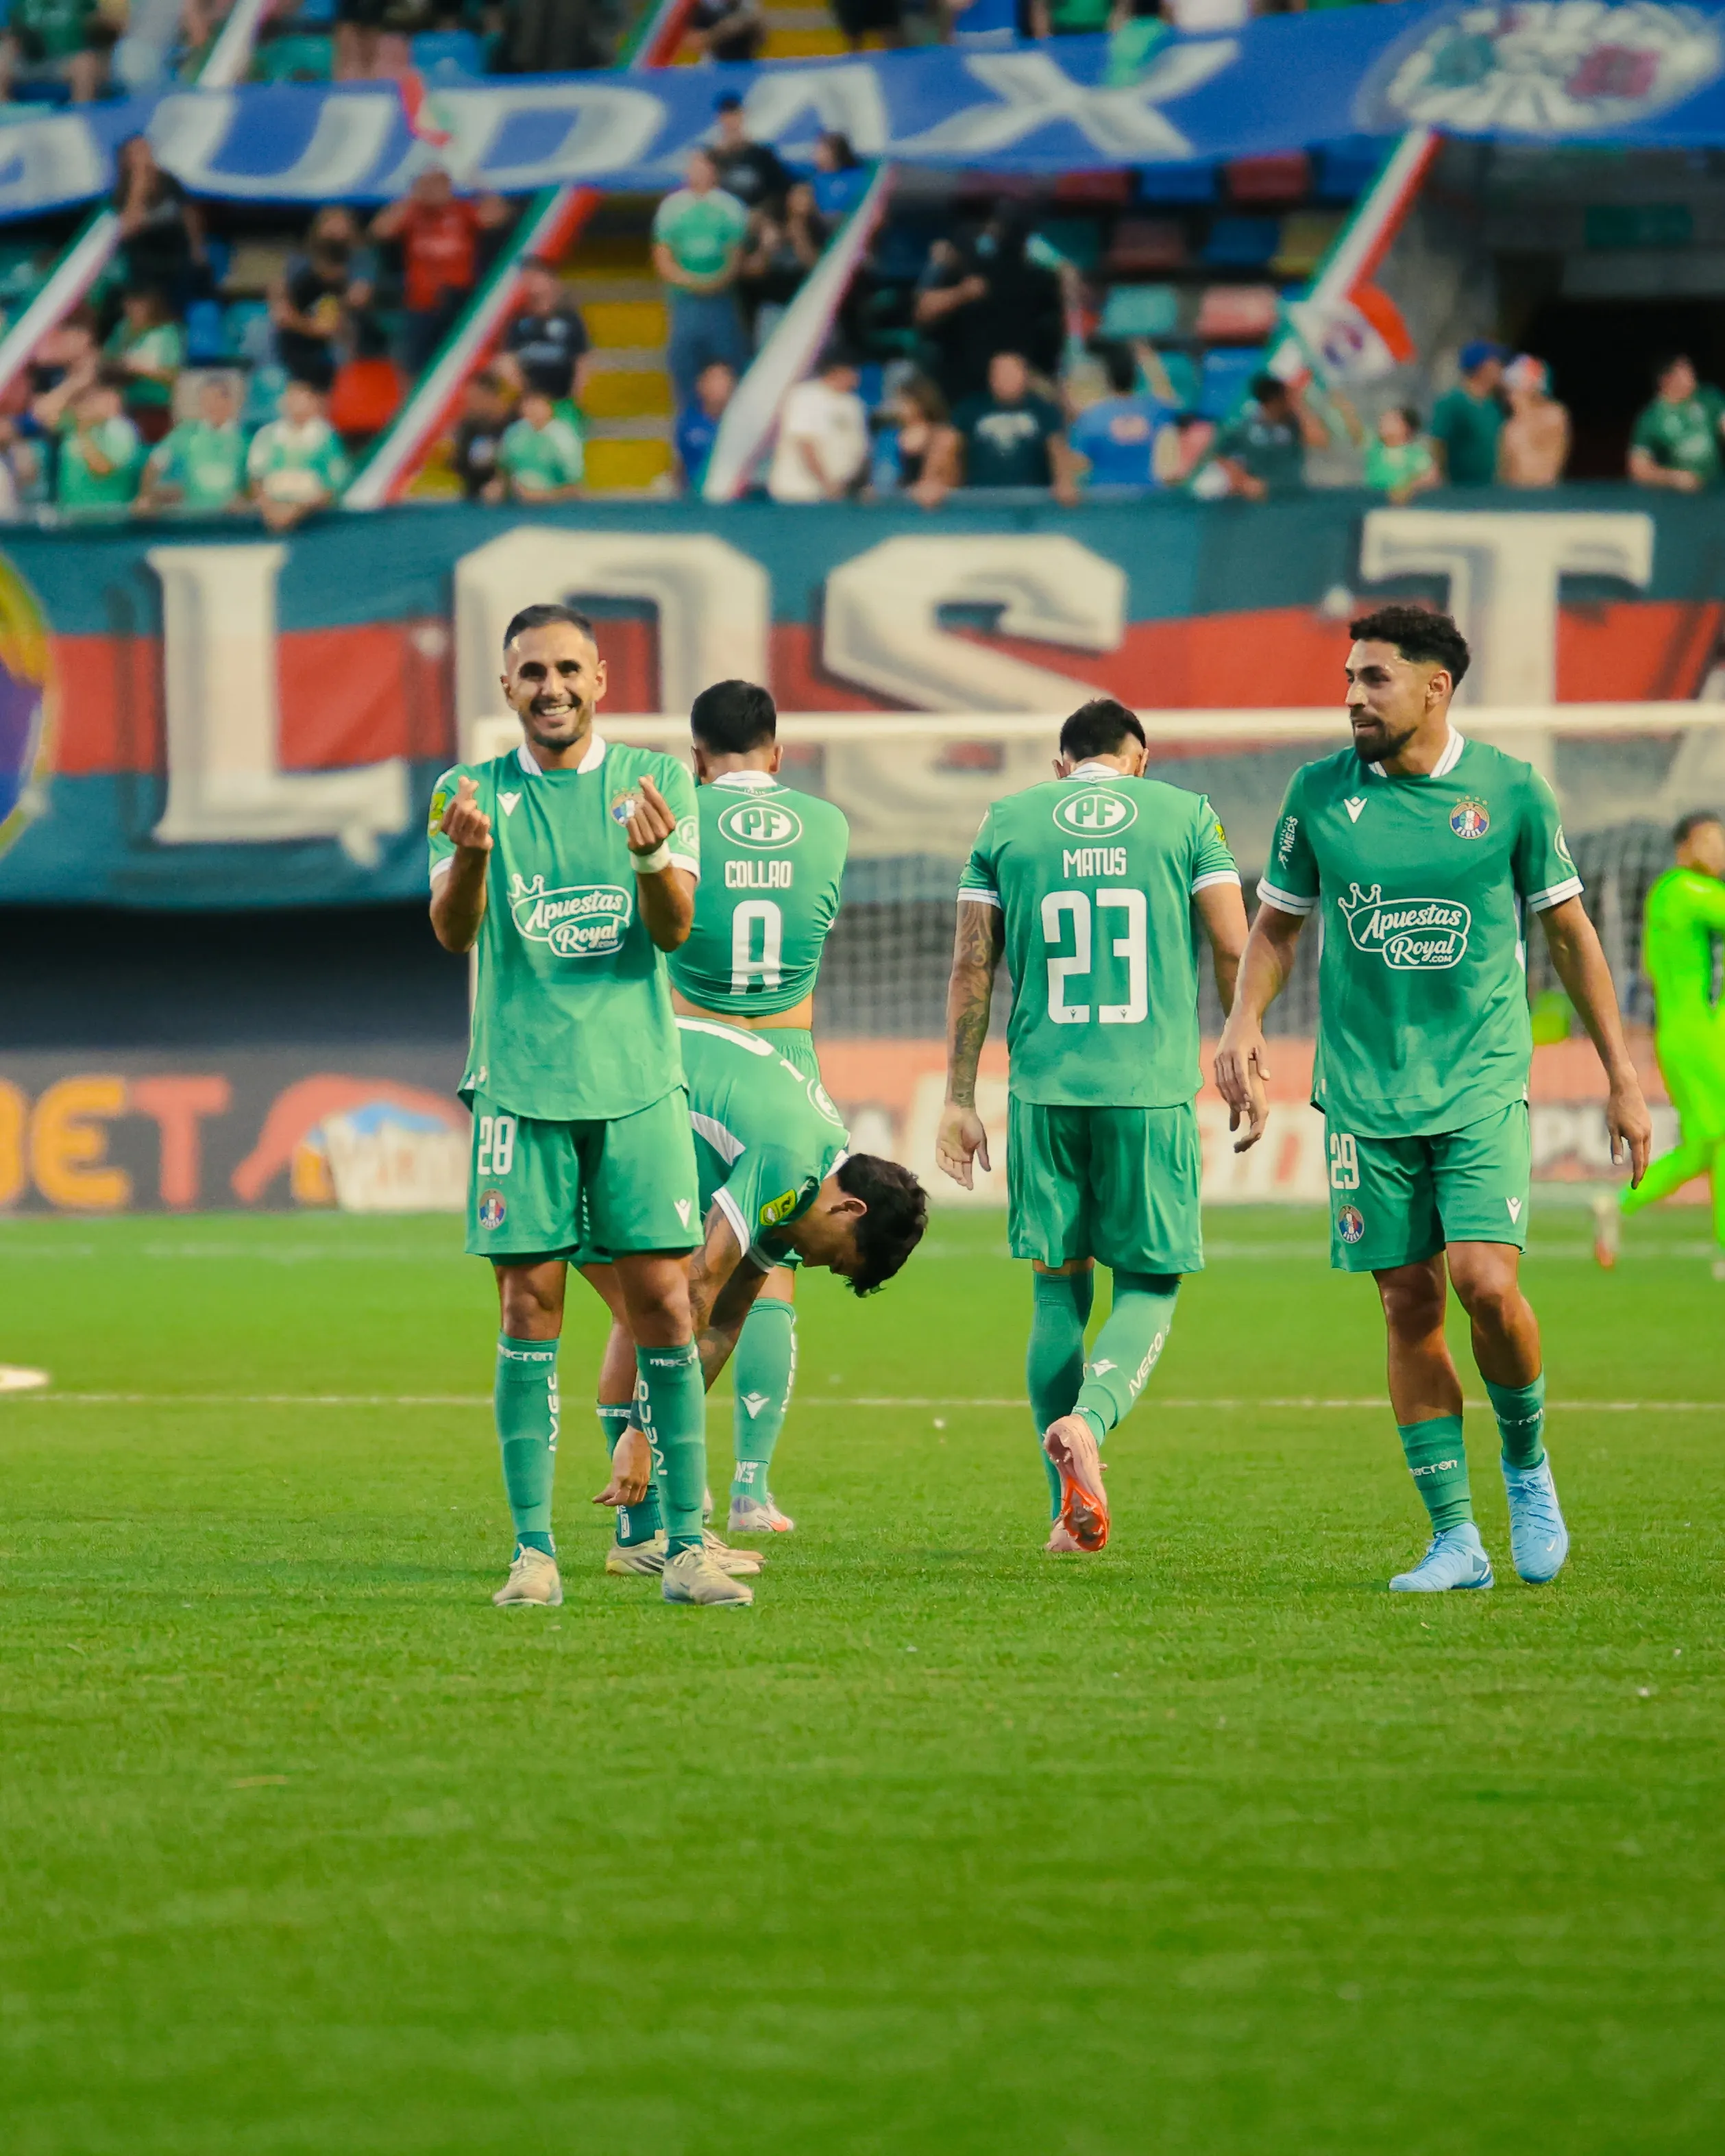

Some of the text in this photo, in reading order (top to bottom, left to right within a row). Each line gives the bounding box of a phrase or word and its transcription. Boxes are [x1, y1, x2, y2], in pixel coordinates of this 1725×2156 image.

[741, 809, 780, 837] PF
[1075, 796, 1115, 826] PF
[724, 860, 792, 888] COLLAO
[1063, 847, 1127, 878] MATUS
[524, 890, 624, 932] Apuestas
[1359, 903, 1463, 944] Apuestas
[555, 918, 619, 952] Royal
[1390, 933, 1456, 965] Royal
[1040, 888, 1149, 1024] 23
[1429, 955, 1452, 963] .COM
[0, 1073, 230, 1209] ET
[478, 1115, 517, 1176] 28
[1330, 1132, 1360, 1190] 29
[1128, 1332, 1163, 1397] IVECO
